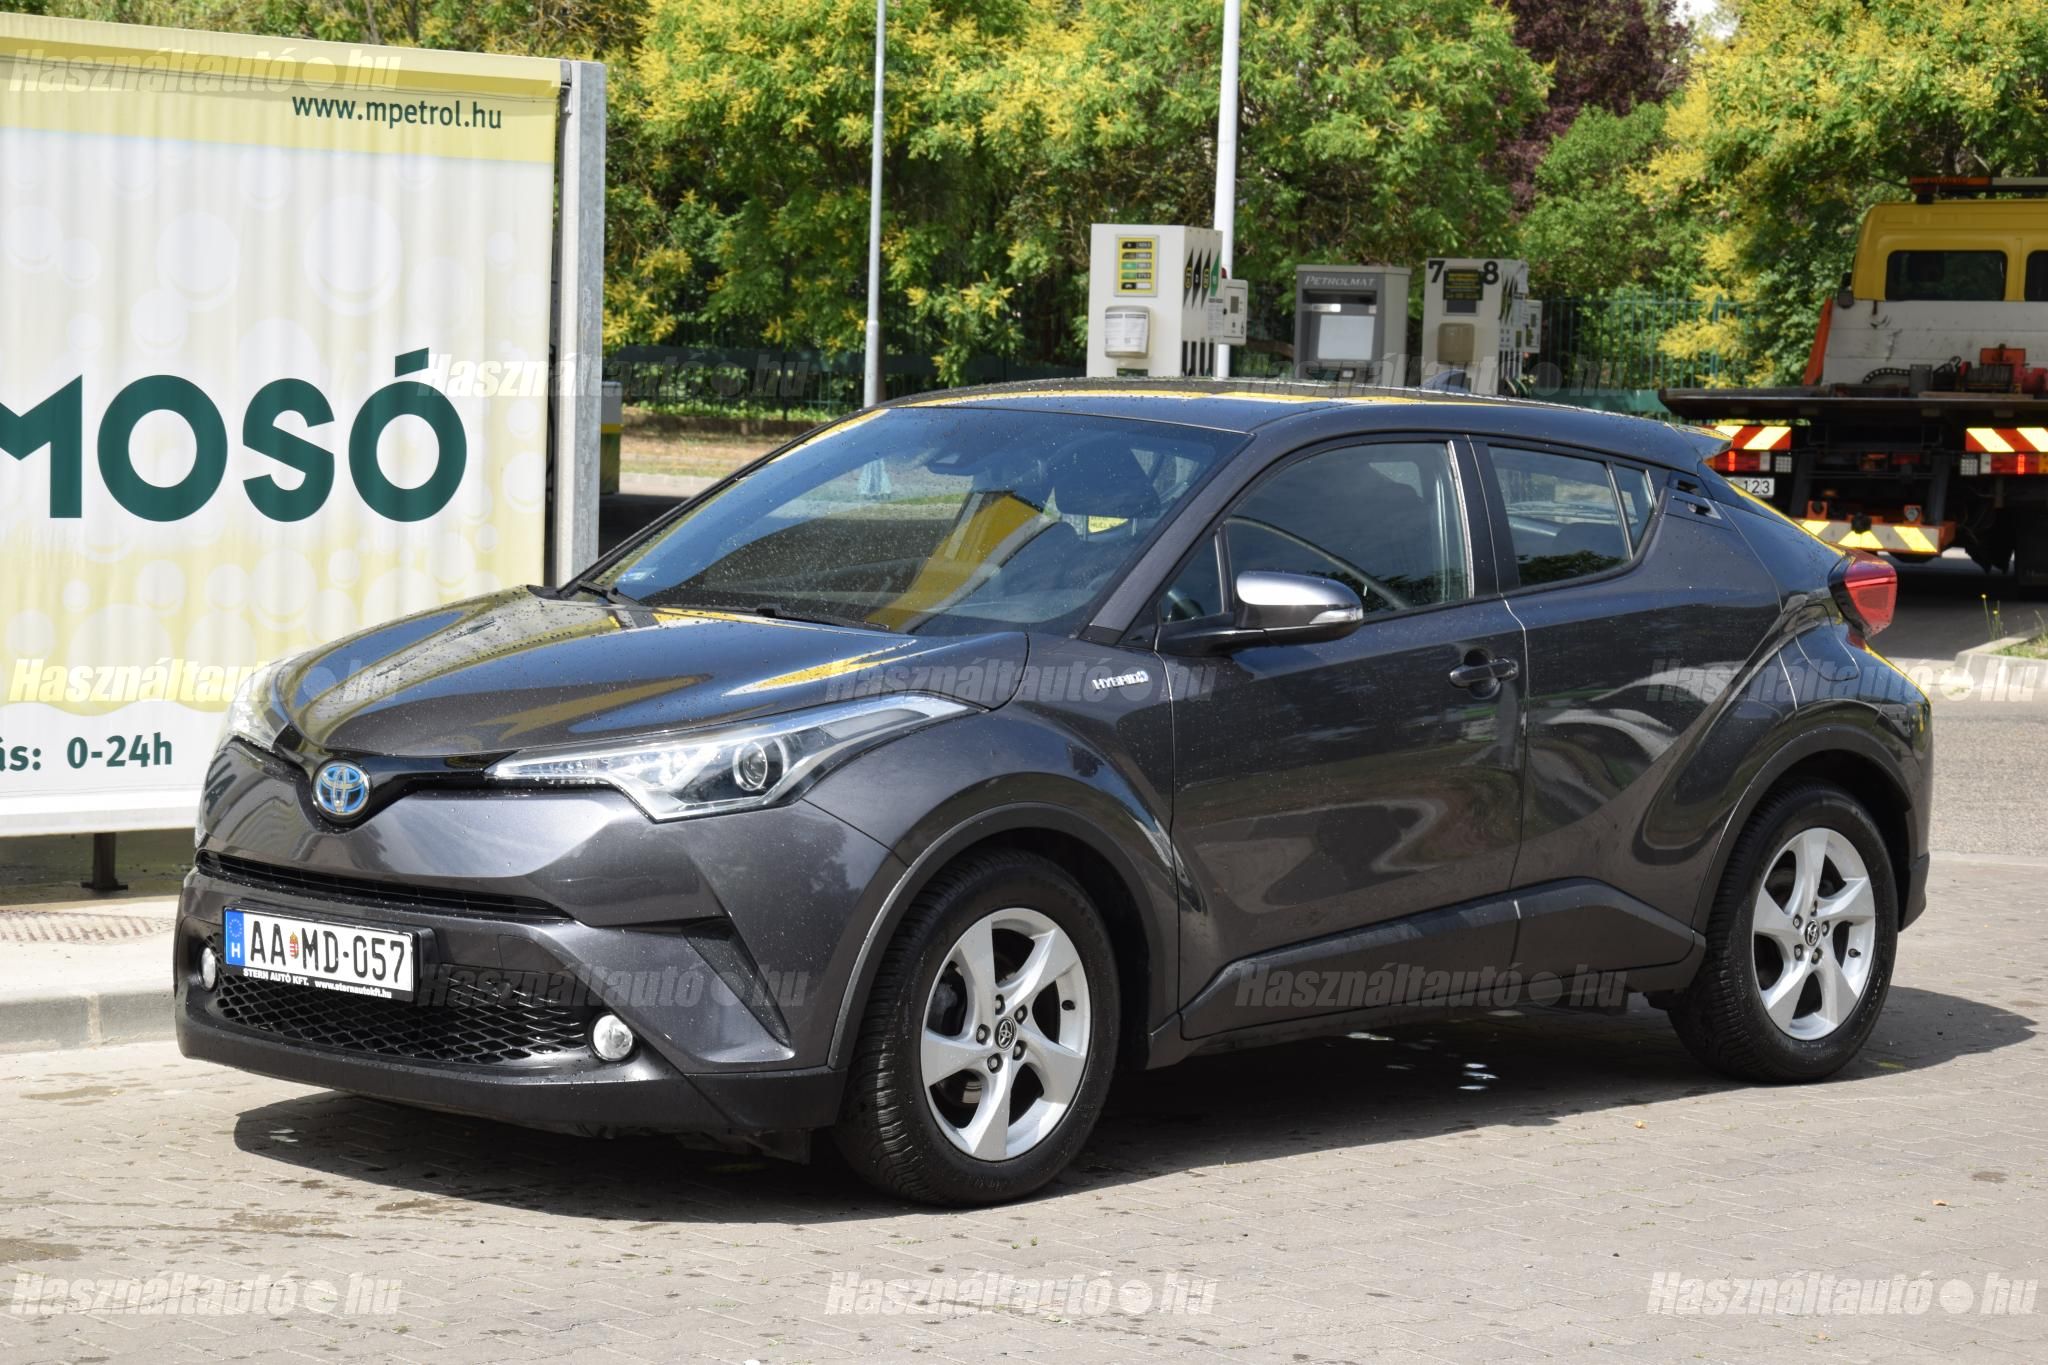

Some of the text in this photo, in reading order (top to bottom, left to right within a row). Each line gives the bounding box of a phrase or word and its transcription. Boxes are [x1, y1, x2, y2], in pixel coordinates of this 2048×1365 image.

[292, 96, 502, 129] www.mpetrol.hu
[1304, 275, 1376, 287] PETROLMAT
[1428, 260, 1446, 283] 7
[1483, 261, 1500, 285] 8
[0, 347, 467, 522] MOSÓ
[1092, 671, 1143, 690] HYBRID
[66, 732, 173, 769] 0-24h
[231, 942, 241, 959] H
[251, 920, 405, 984] AA MD-057
[243, 968, 269, 980] STERN
[292, 975, 310, 986] KFT.
